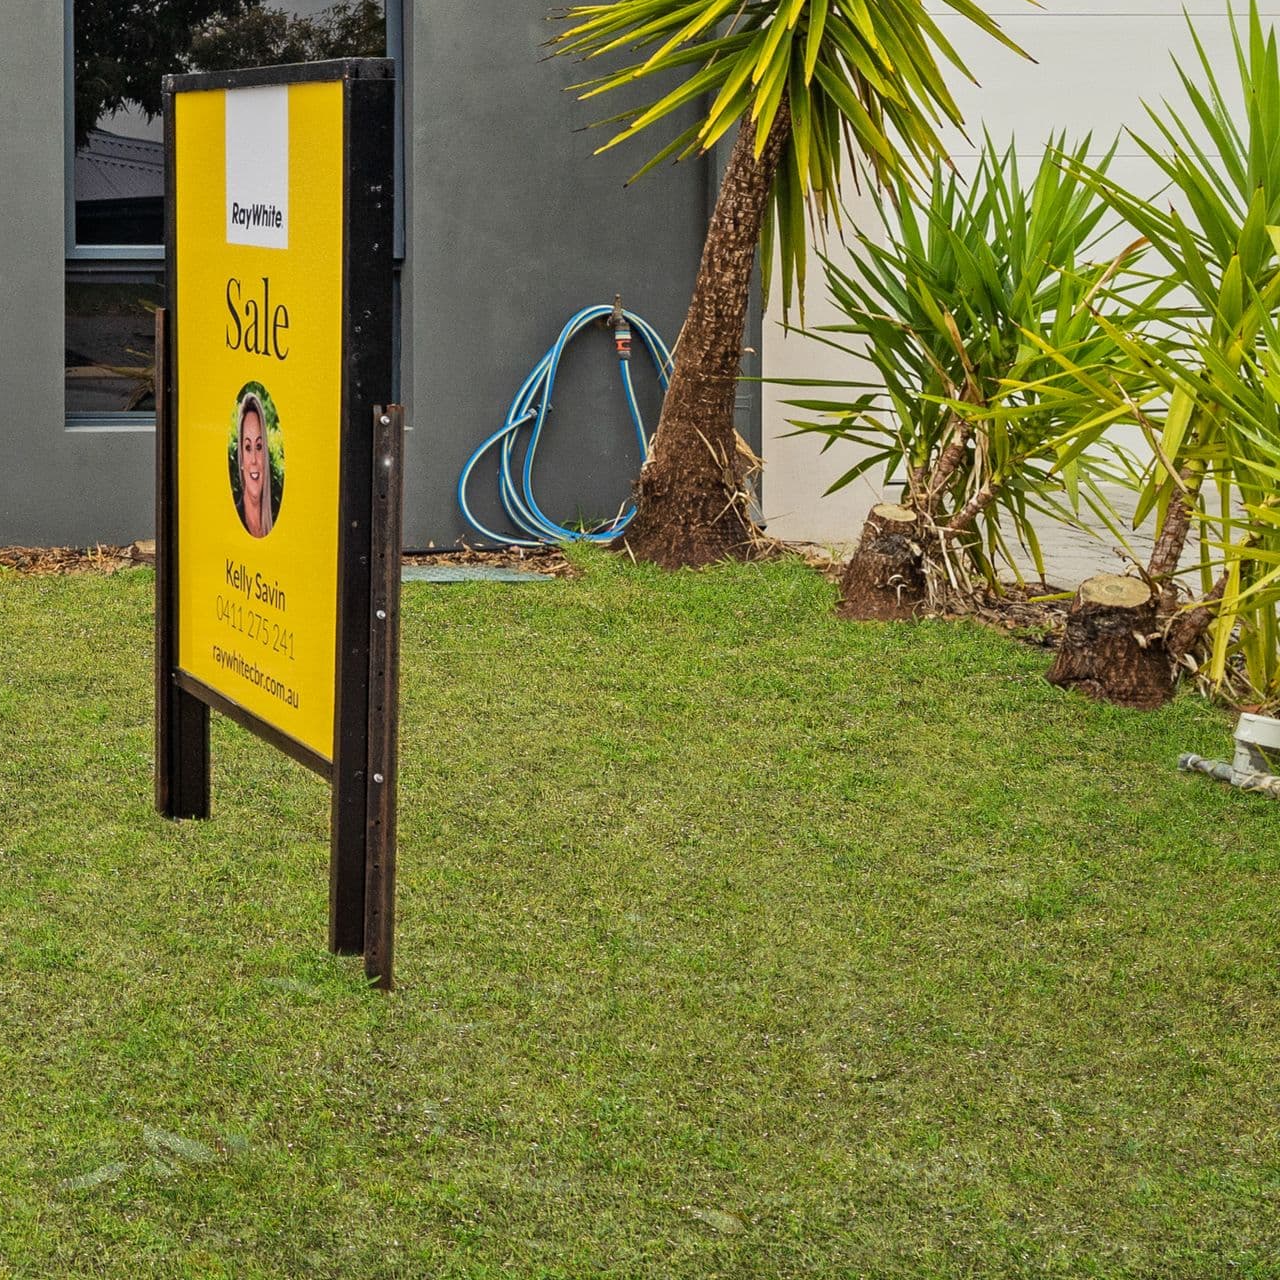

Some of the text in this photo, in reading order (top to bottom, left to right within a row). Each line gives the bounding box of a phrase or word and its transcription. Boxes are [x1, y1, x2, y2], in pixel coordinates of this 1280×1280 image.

[226, 277, 290, 361] Sale
[226, 558, 286, 612] Kelly Savin
[216, 595, 296, 661] 0411 275 241
